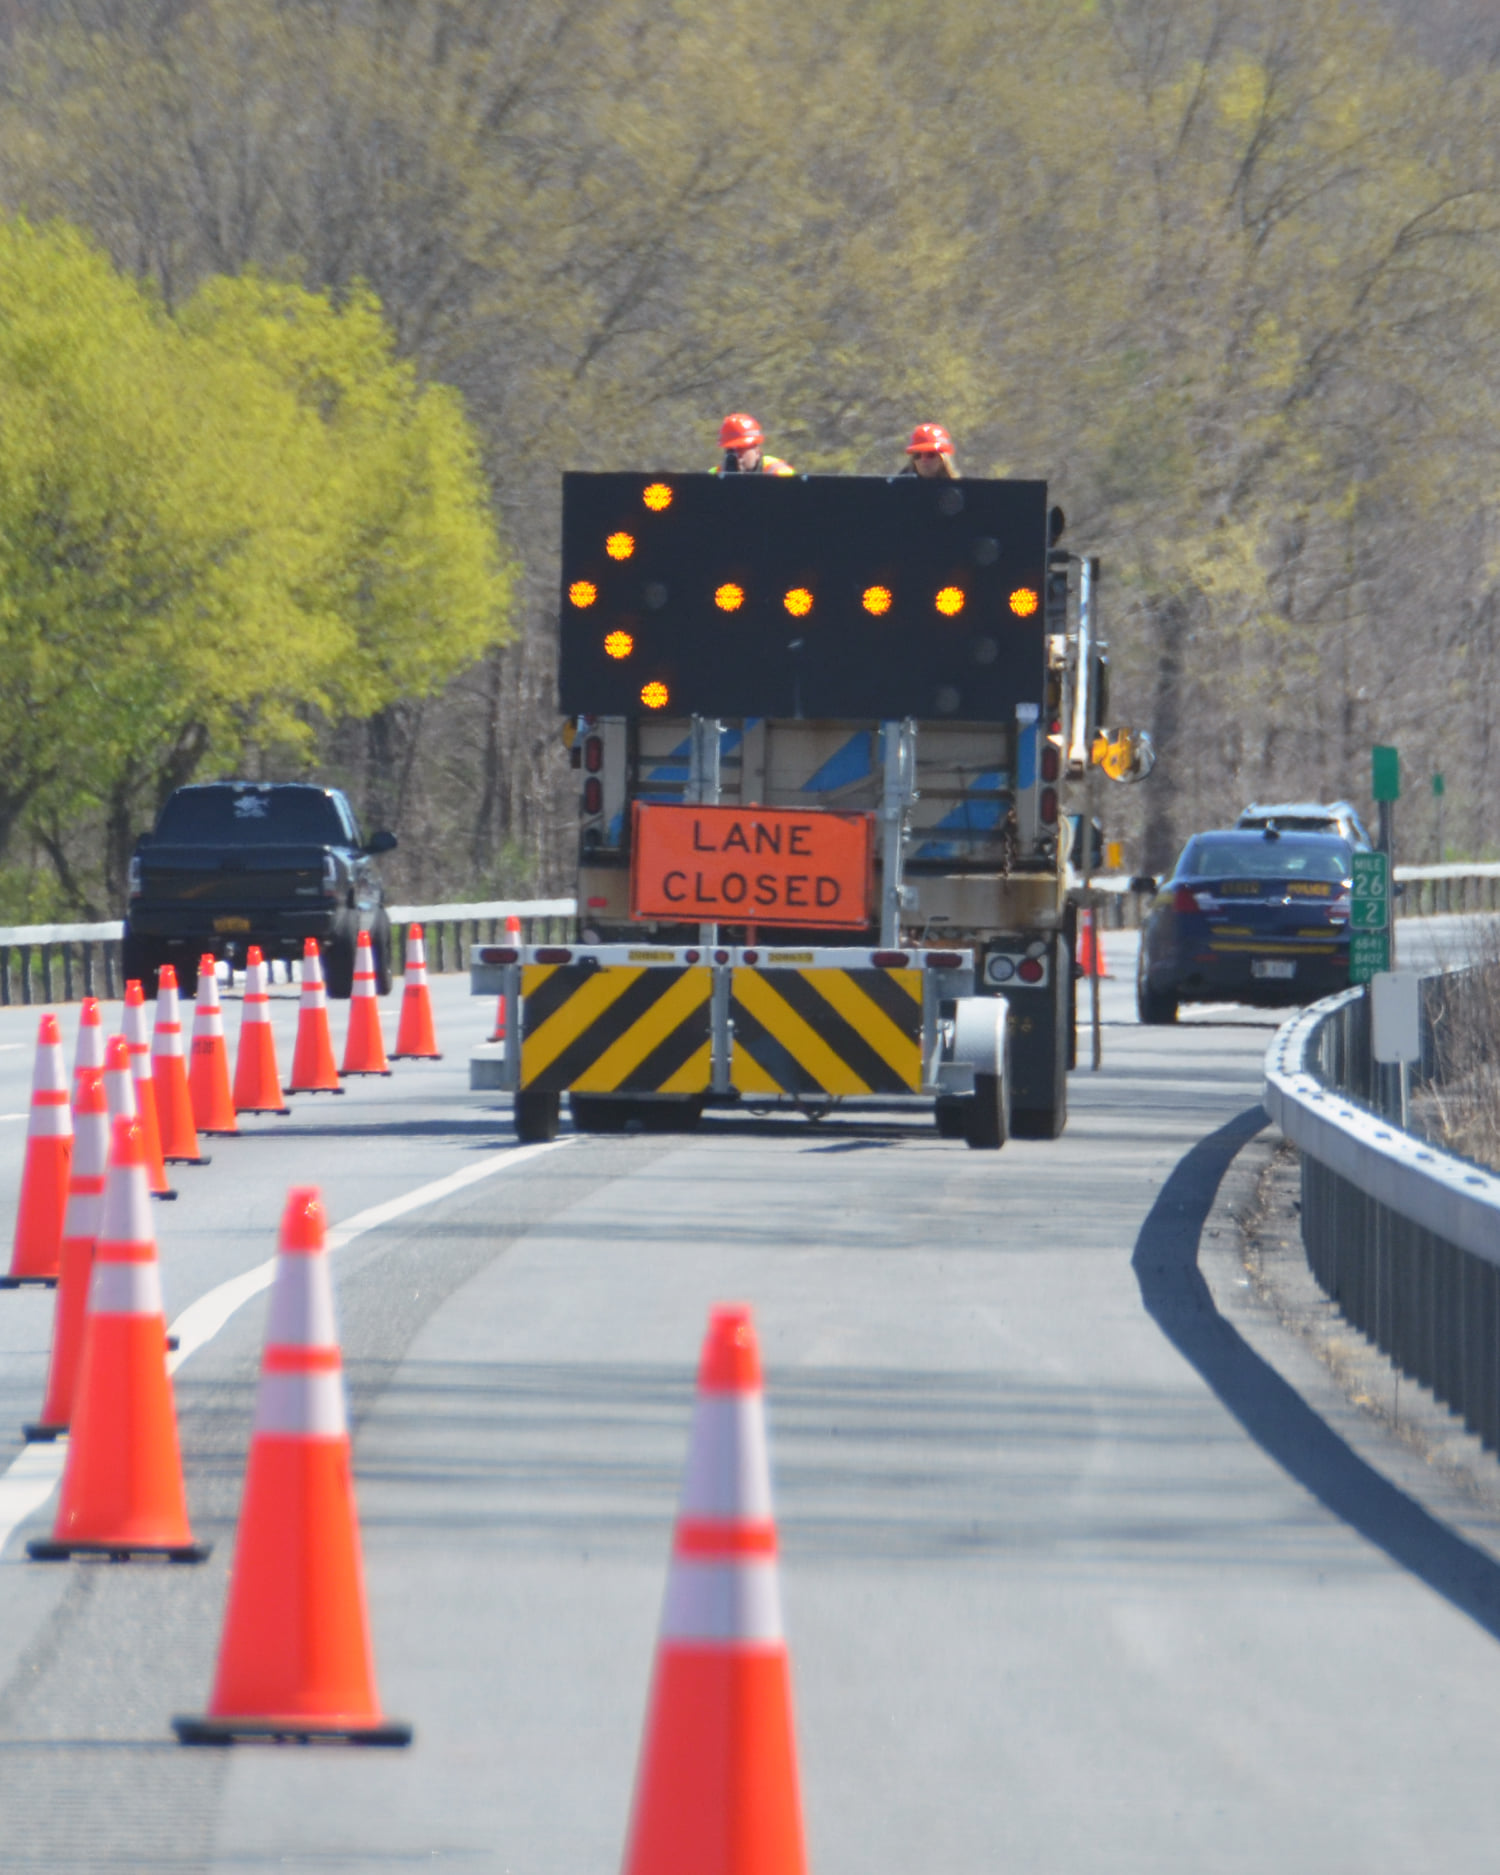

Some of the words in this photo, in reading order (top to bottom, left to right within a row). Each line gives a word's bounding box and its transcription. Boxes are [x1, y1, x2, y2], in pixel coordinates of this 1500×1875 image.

[693, 820, 813, 856] LANE
[1354, 858, 1382, 872] MILE
[662, 870, 841, 907] CLOSED
[1355, 874, 1384, 897] 26
